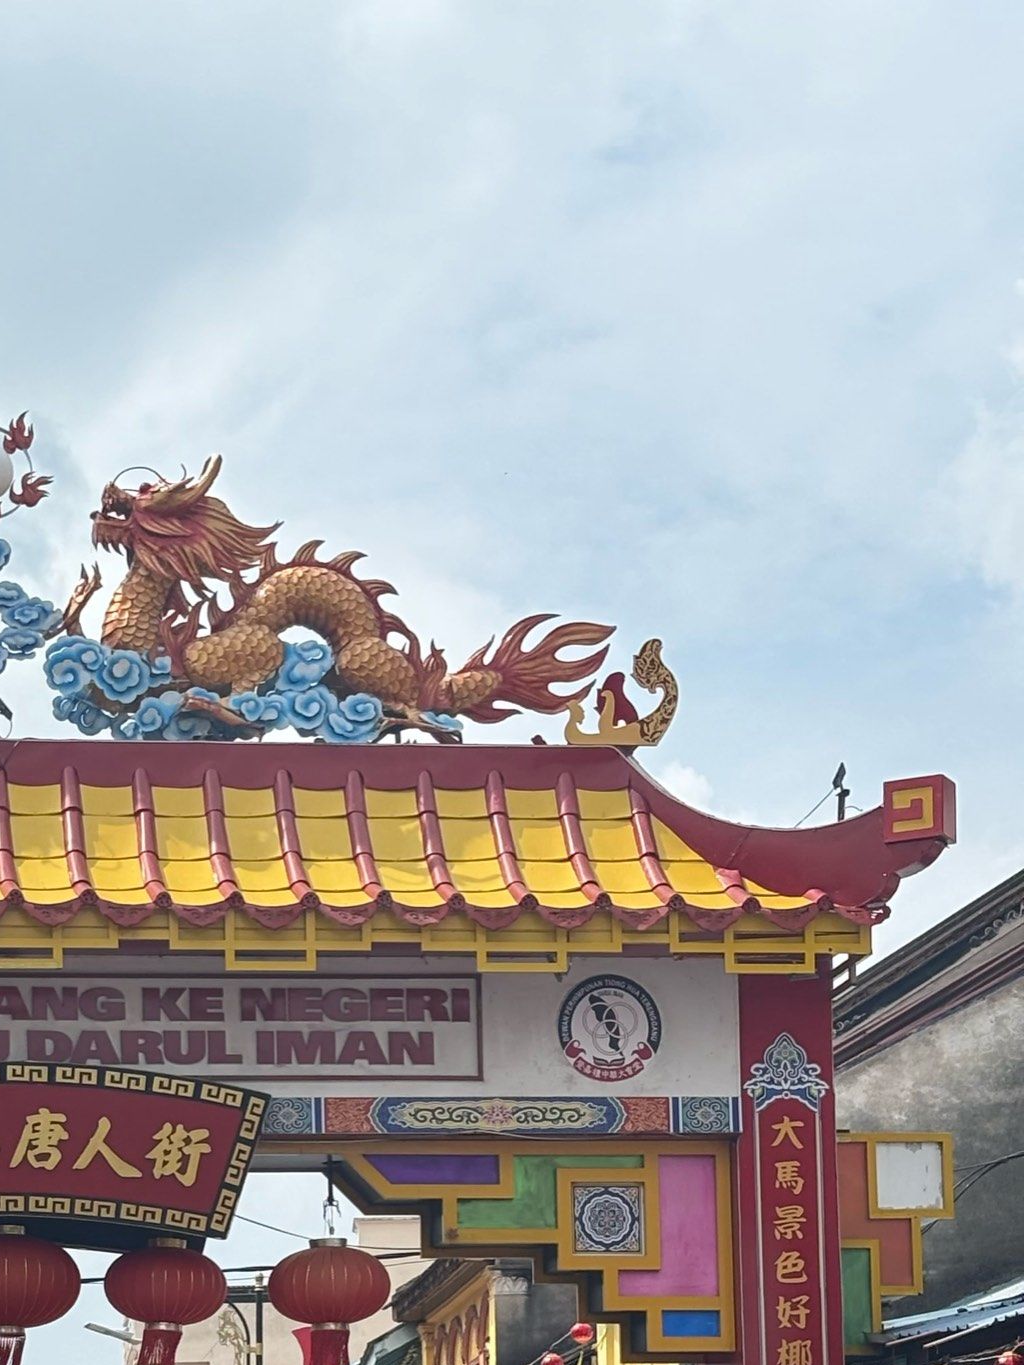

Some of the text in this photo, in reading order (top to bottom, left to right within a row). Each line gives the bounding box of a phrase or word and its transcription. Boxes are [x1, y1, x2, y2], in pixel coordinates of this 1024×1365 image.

[141, 986, 224, 1022] KE
[240, 987, 471, 1023] NEGERI
[26, 1029, 243, 1065] DARUL
[256, 1030, 435, 1065] IMAN
